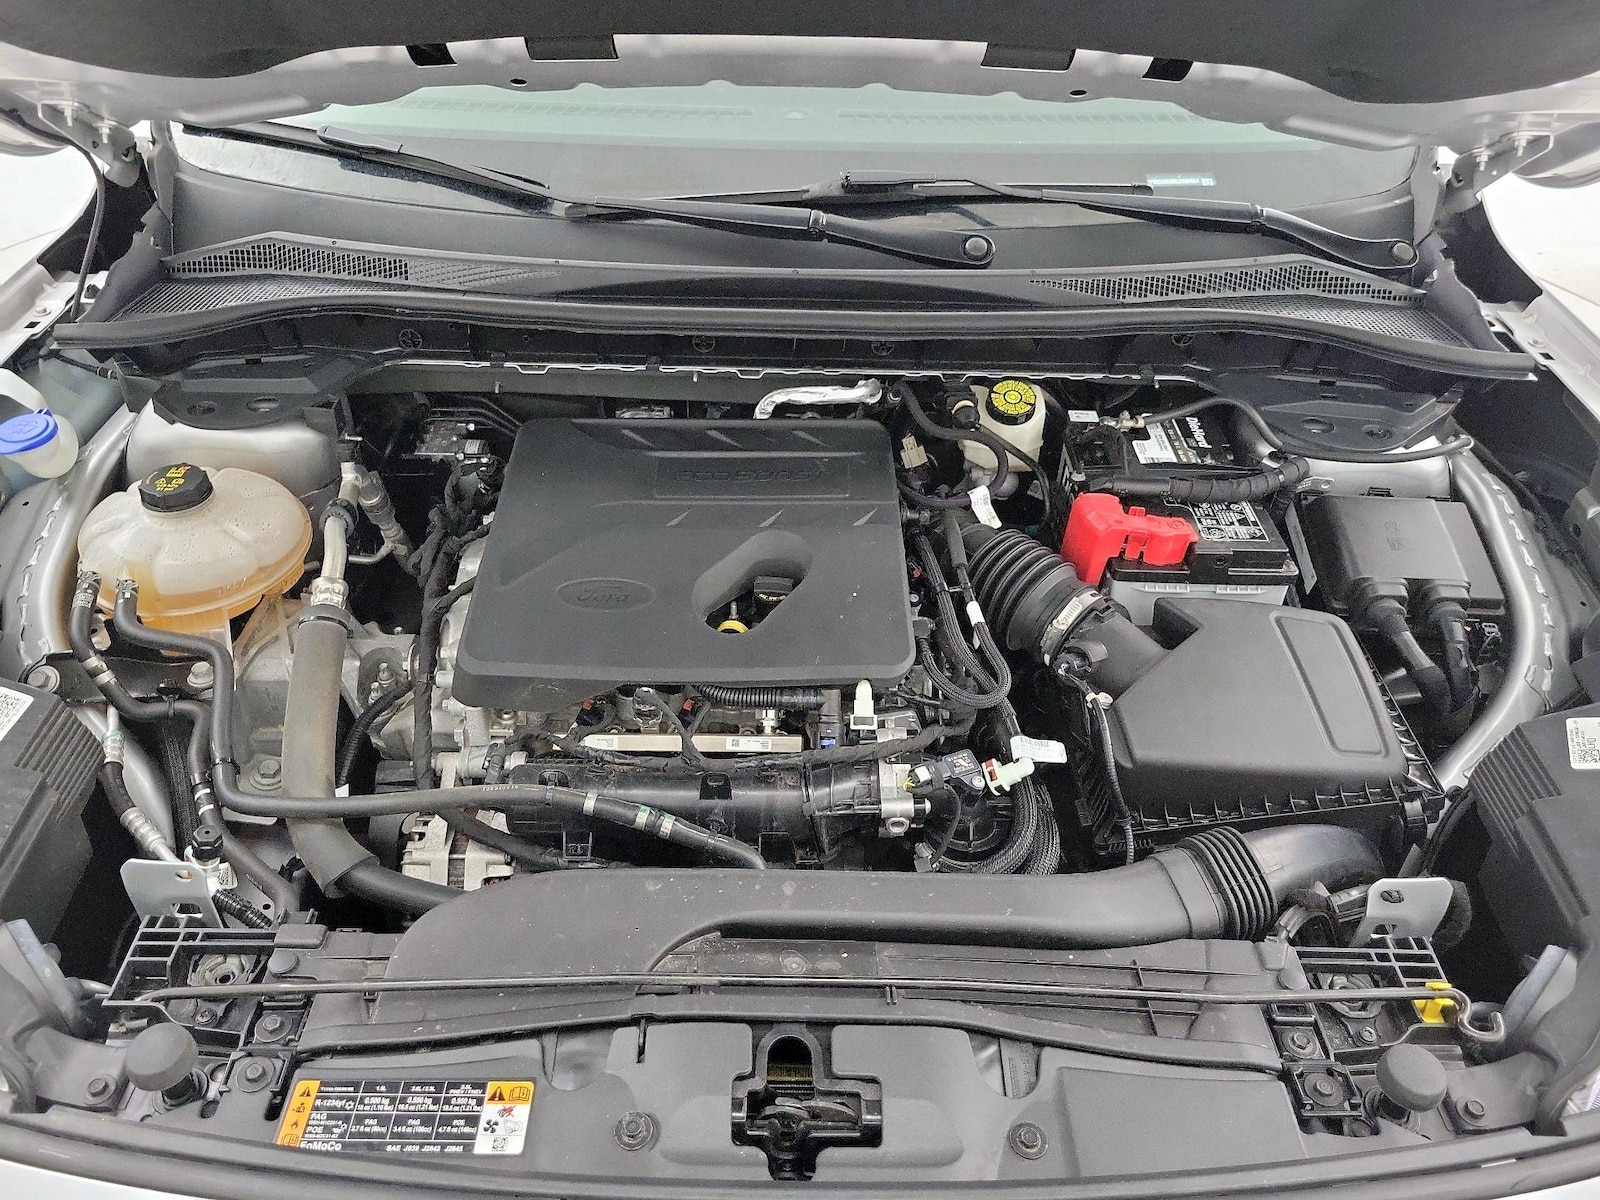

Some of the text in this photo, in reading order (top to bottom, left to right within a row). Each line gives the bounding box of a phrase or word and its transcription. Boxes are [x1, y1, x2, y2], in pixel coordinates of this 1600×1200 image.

[1185, 416, 1213, 449] DieHard
[576, 582, 634, 602] Ford
[299, 1141, 342, 1151] FoMoCo
